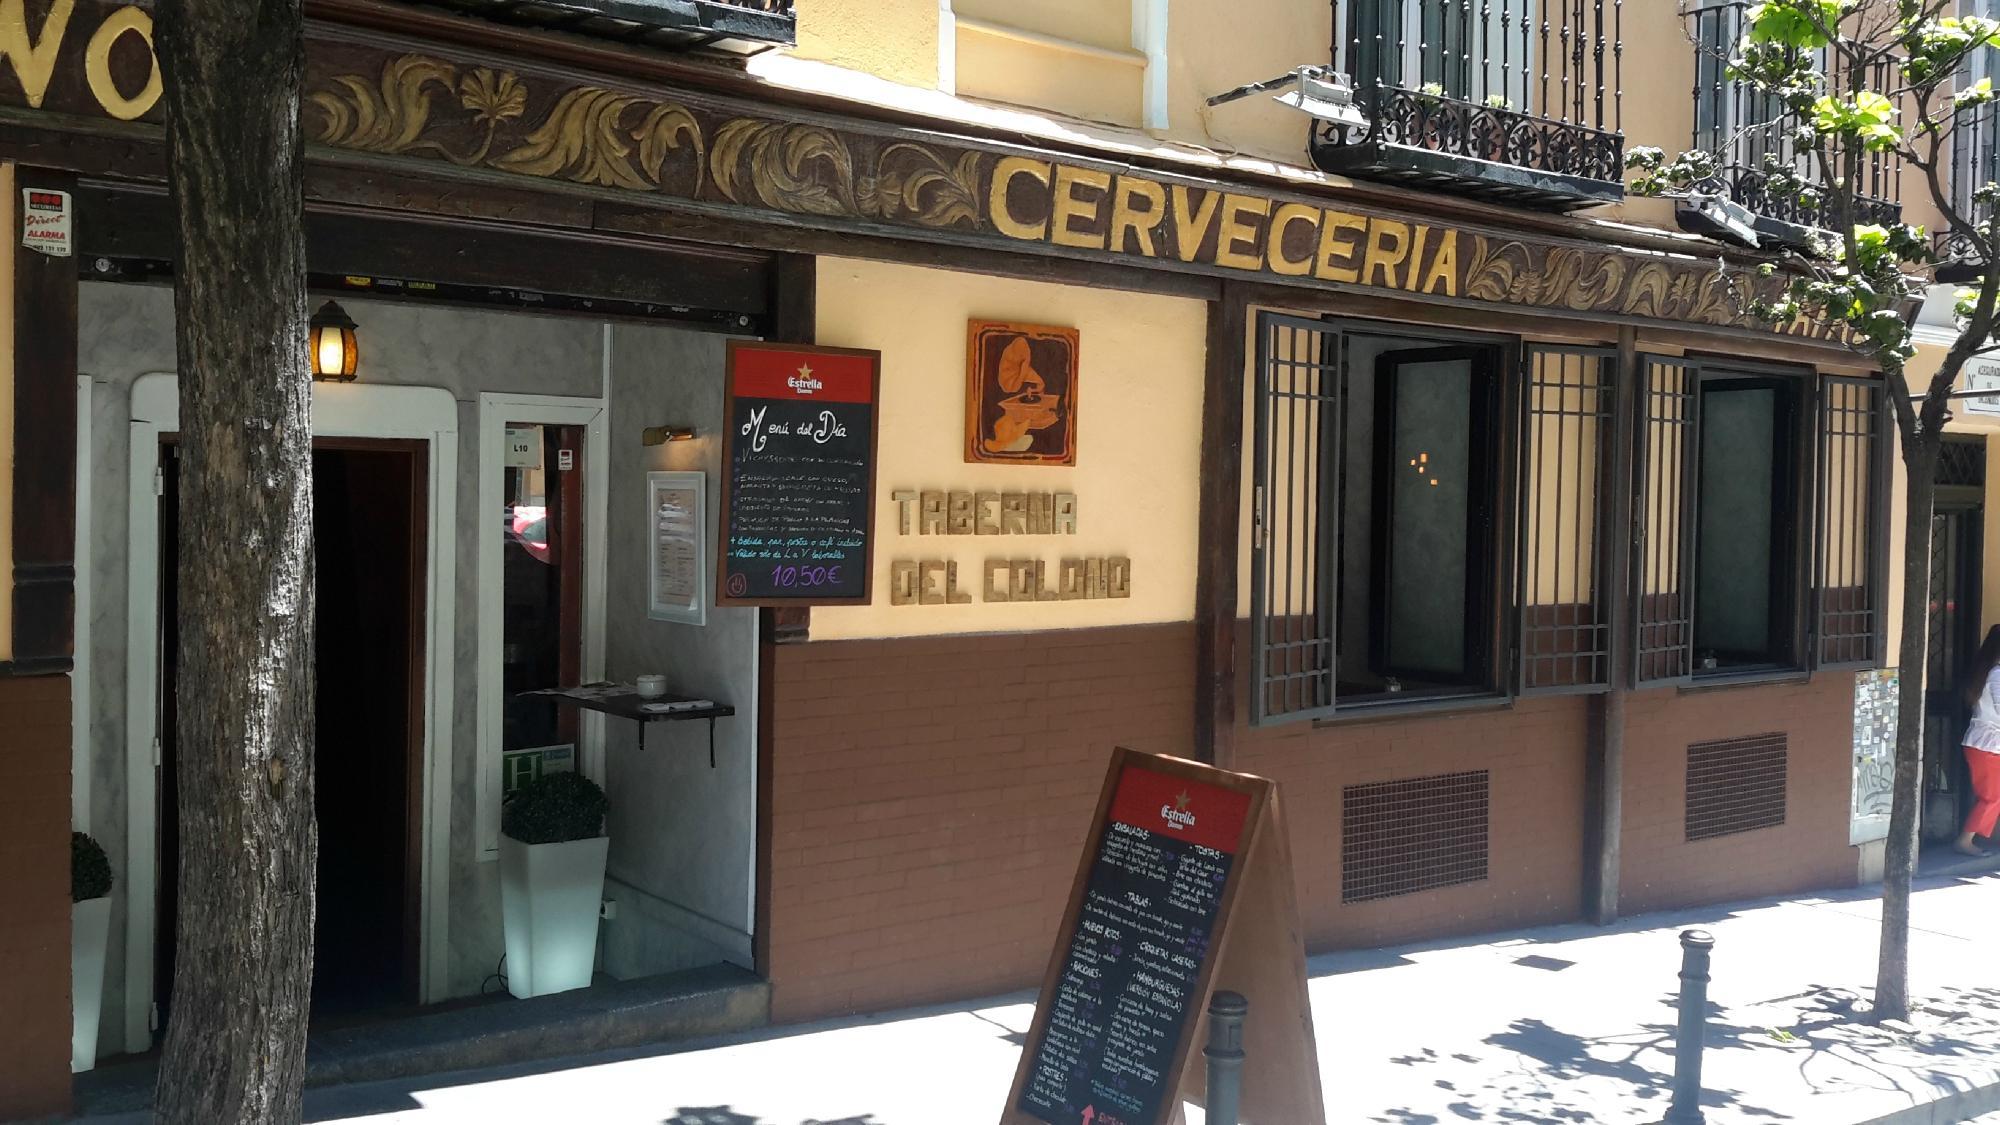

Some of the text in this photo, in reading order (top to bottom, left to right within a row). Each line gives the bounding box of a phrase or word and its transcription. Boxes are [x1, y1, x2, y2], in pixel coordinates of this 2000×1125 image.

[27, 230, 65, 239] ALARMA
[989, 157, 1457, 297] CERVECERIA
[788, 376, 822, 390] Estrella
[742, 405, 847, 452] Menú del Día
[513, 444, 528, 452] L10
[892, 490, 1077, 535] TABERNA
[771, 564, 843, 588] 10,50€
[891, 558, 1130, 606] DEL COLONO
[1161, 806, 1196, 826] Estrella
[1125, 891, 1149, 908] TABLAS
[1138, 940, 1169, 960] CROQUETAS
[1134, 970, 1181, 998] HAMBURGUESAS
